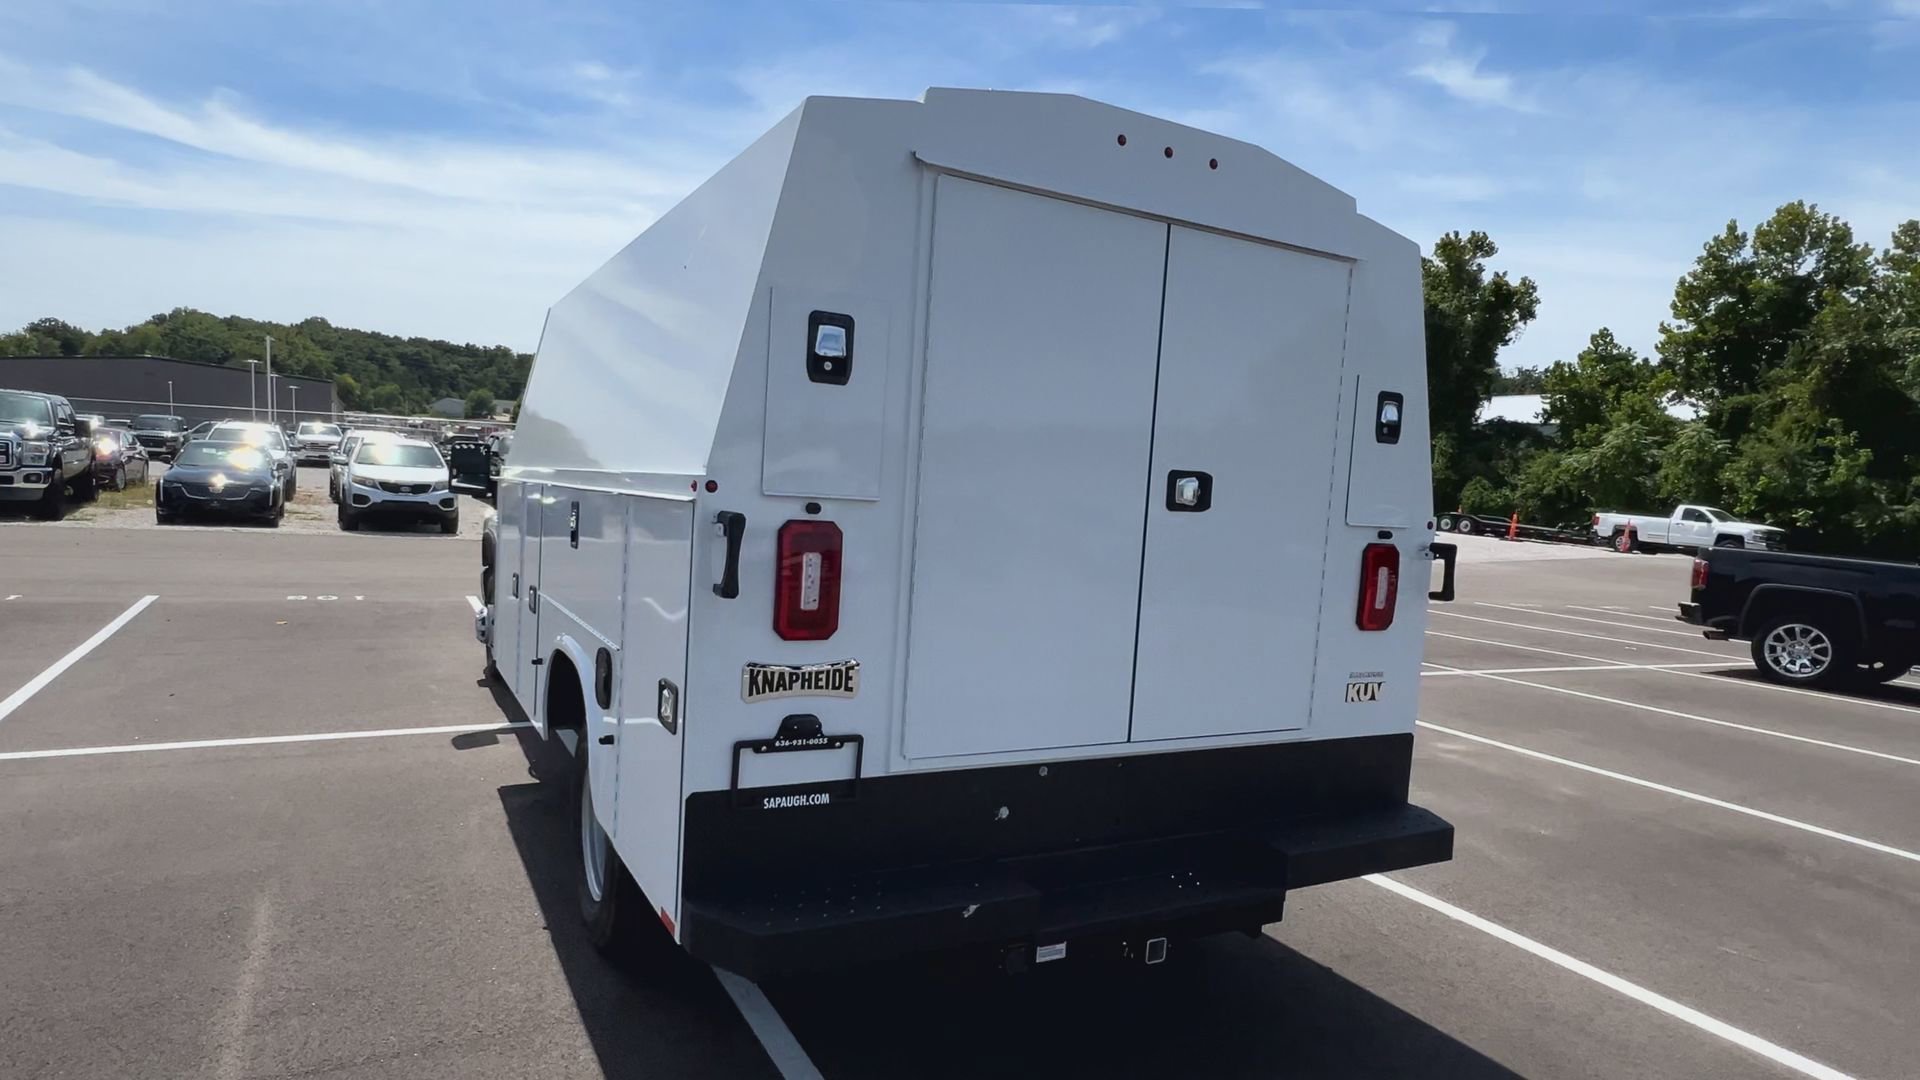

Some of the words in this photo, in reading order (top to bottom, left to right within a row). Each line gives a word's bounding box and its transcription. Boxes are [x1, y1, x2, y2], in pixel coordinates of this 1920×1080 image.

[748, 666, 855, 697] KNAPHEIDE
[1345, 681, 1386, 703] KUV
[775, 737, 828, 747] 636-931-0055
[763, 793, 830, 809] SAPAUGH.COM
